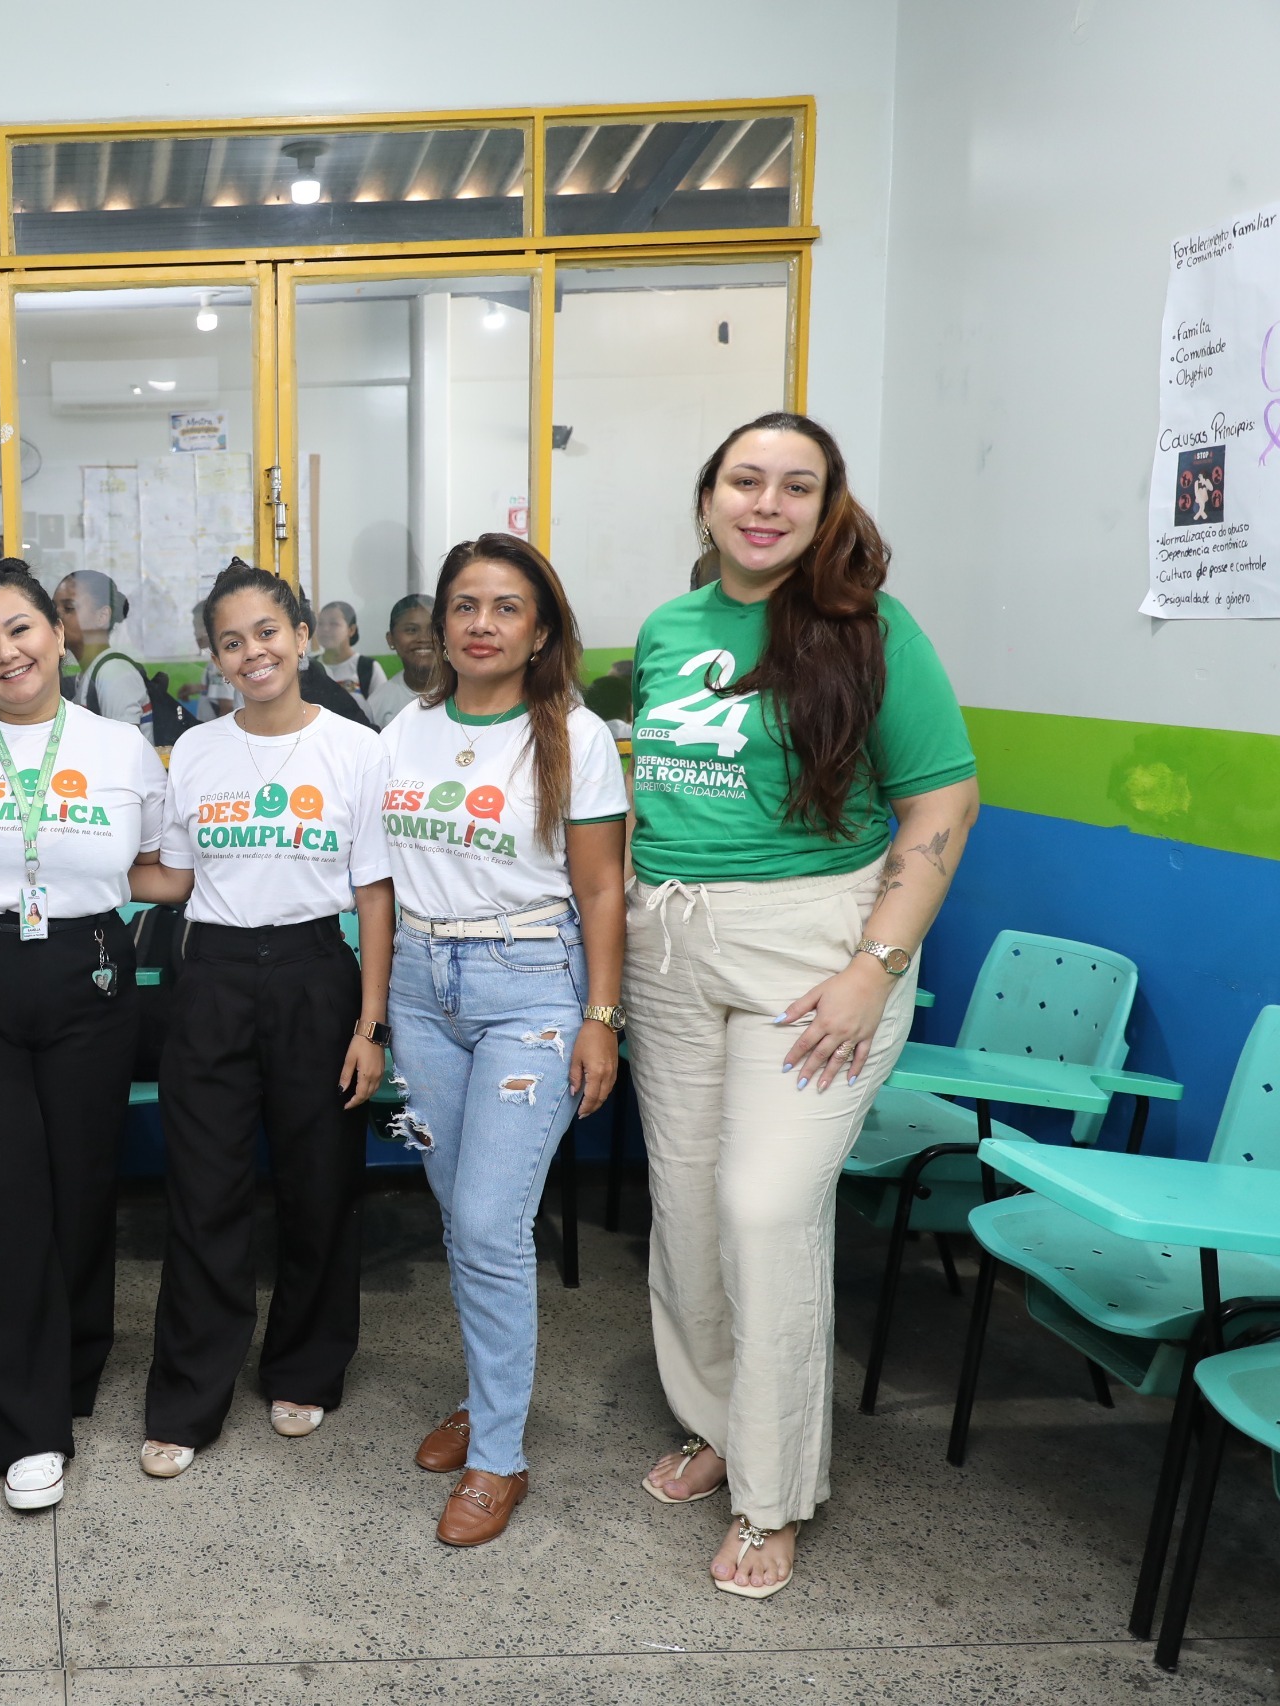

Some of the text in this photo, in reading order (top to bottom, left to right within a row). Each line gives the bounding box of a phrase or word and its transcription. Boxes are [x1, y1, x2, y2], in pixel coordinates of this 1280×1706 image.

[1232, 212, 1277, 239] Familiar
[1176, 259, 1184, 270] e
[1160, 428, 1208, 452] Causas
[1159, 567, 1192, 583] Cultura
[1209, 563, 1228, 579] posse
[1230, 562, 1234, 572] e
[1236, 554, 1267, 572] controle
[640, 728, 671, 739] anos
[637, 755, 746, 775] DEFENSORIA PÚBLICA
[387, 779, 425, 790] ROJETO
[635, 765, 748, 790] DE RORAIMA
[200, 790, 251, 804] PROGRAMA
[635, 782, 746, 800] DIREITOS E CIDADANIA
[197, 801, 251, 824] DES
[197, 822, 340, 852] COMPLICA
